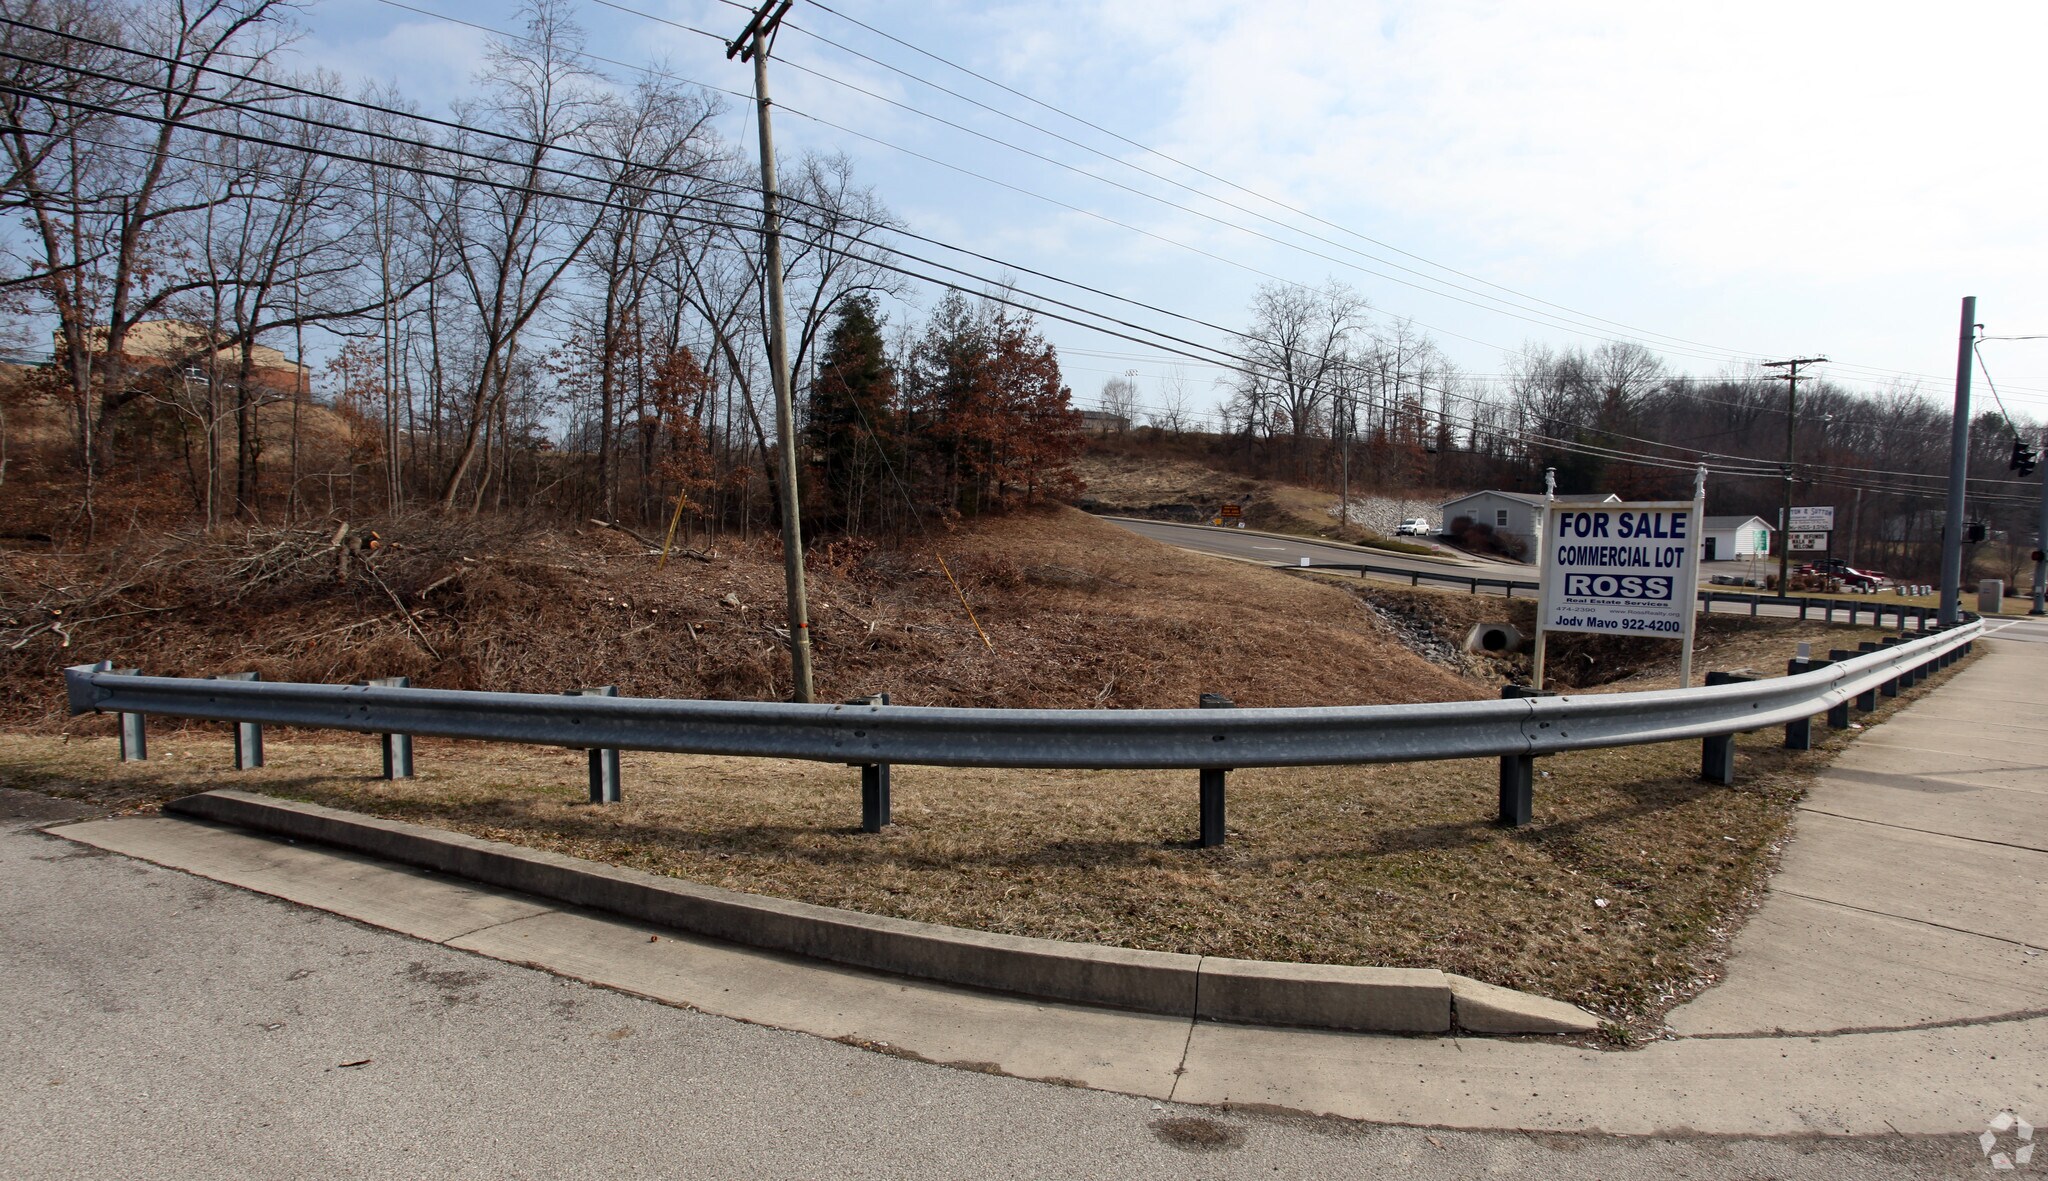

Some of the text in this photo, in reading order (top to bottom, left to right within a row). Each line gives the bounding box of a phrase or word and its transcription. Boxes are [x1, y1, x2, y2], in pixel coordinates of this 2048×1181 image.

[1559, 512, 1687, 539] FOR SALE
[1557, 545, 1685, 568] COMMERCIAL LOT
[1568, 575, 1669, 599] ROSS
[1621, 618, 1680, 632] 922-4200
